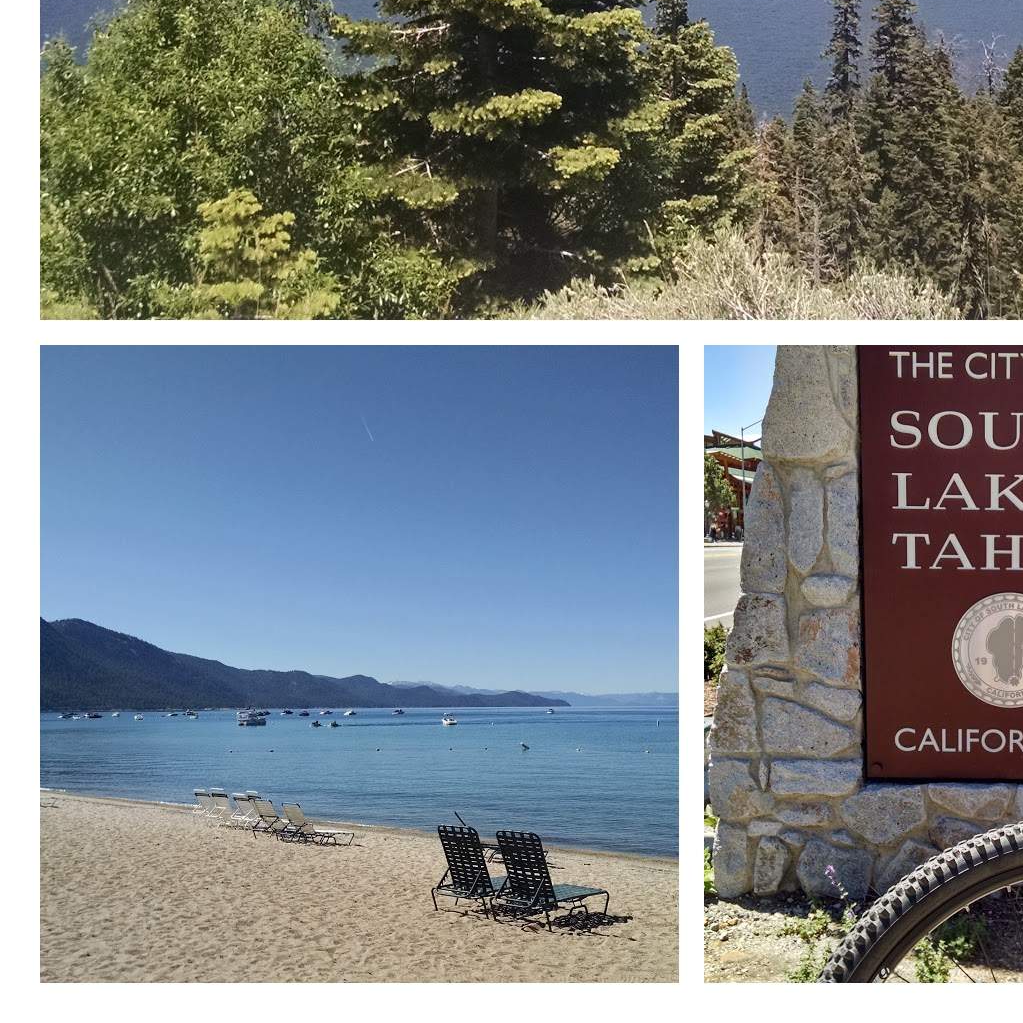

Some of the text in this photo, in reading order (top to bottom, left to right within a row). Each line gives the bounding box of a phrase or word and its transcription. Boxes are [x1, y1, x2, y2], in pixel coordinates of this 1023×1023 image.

[889, 351, 953, 379] THE
[964, 622, 975, 640] CITY
[985, 602, 1015, 616] SOUTH
[975, 657, 988, 666] 19
